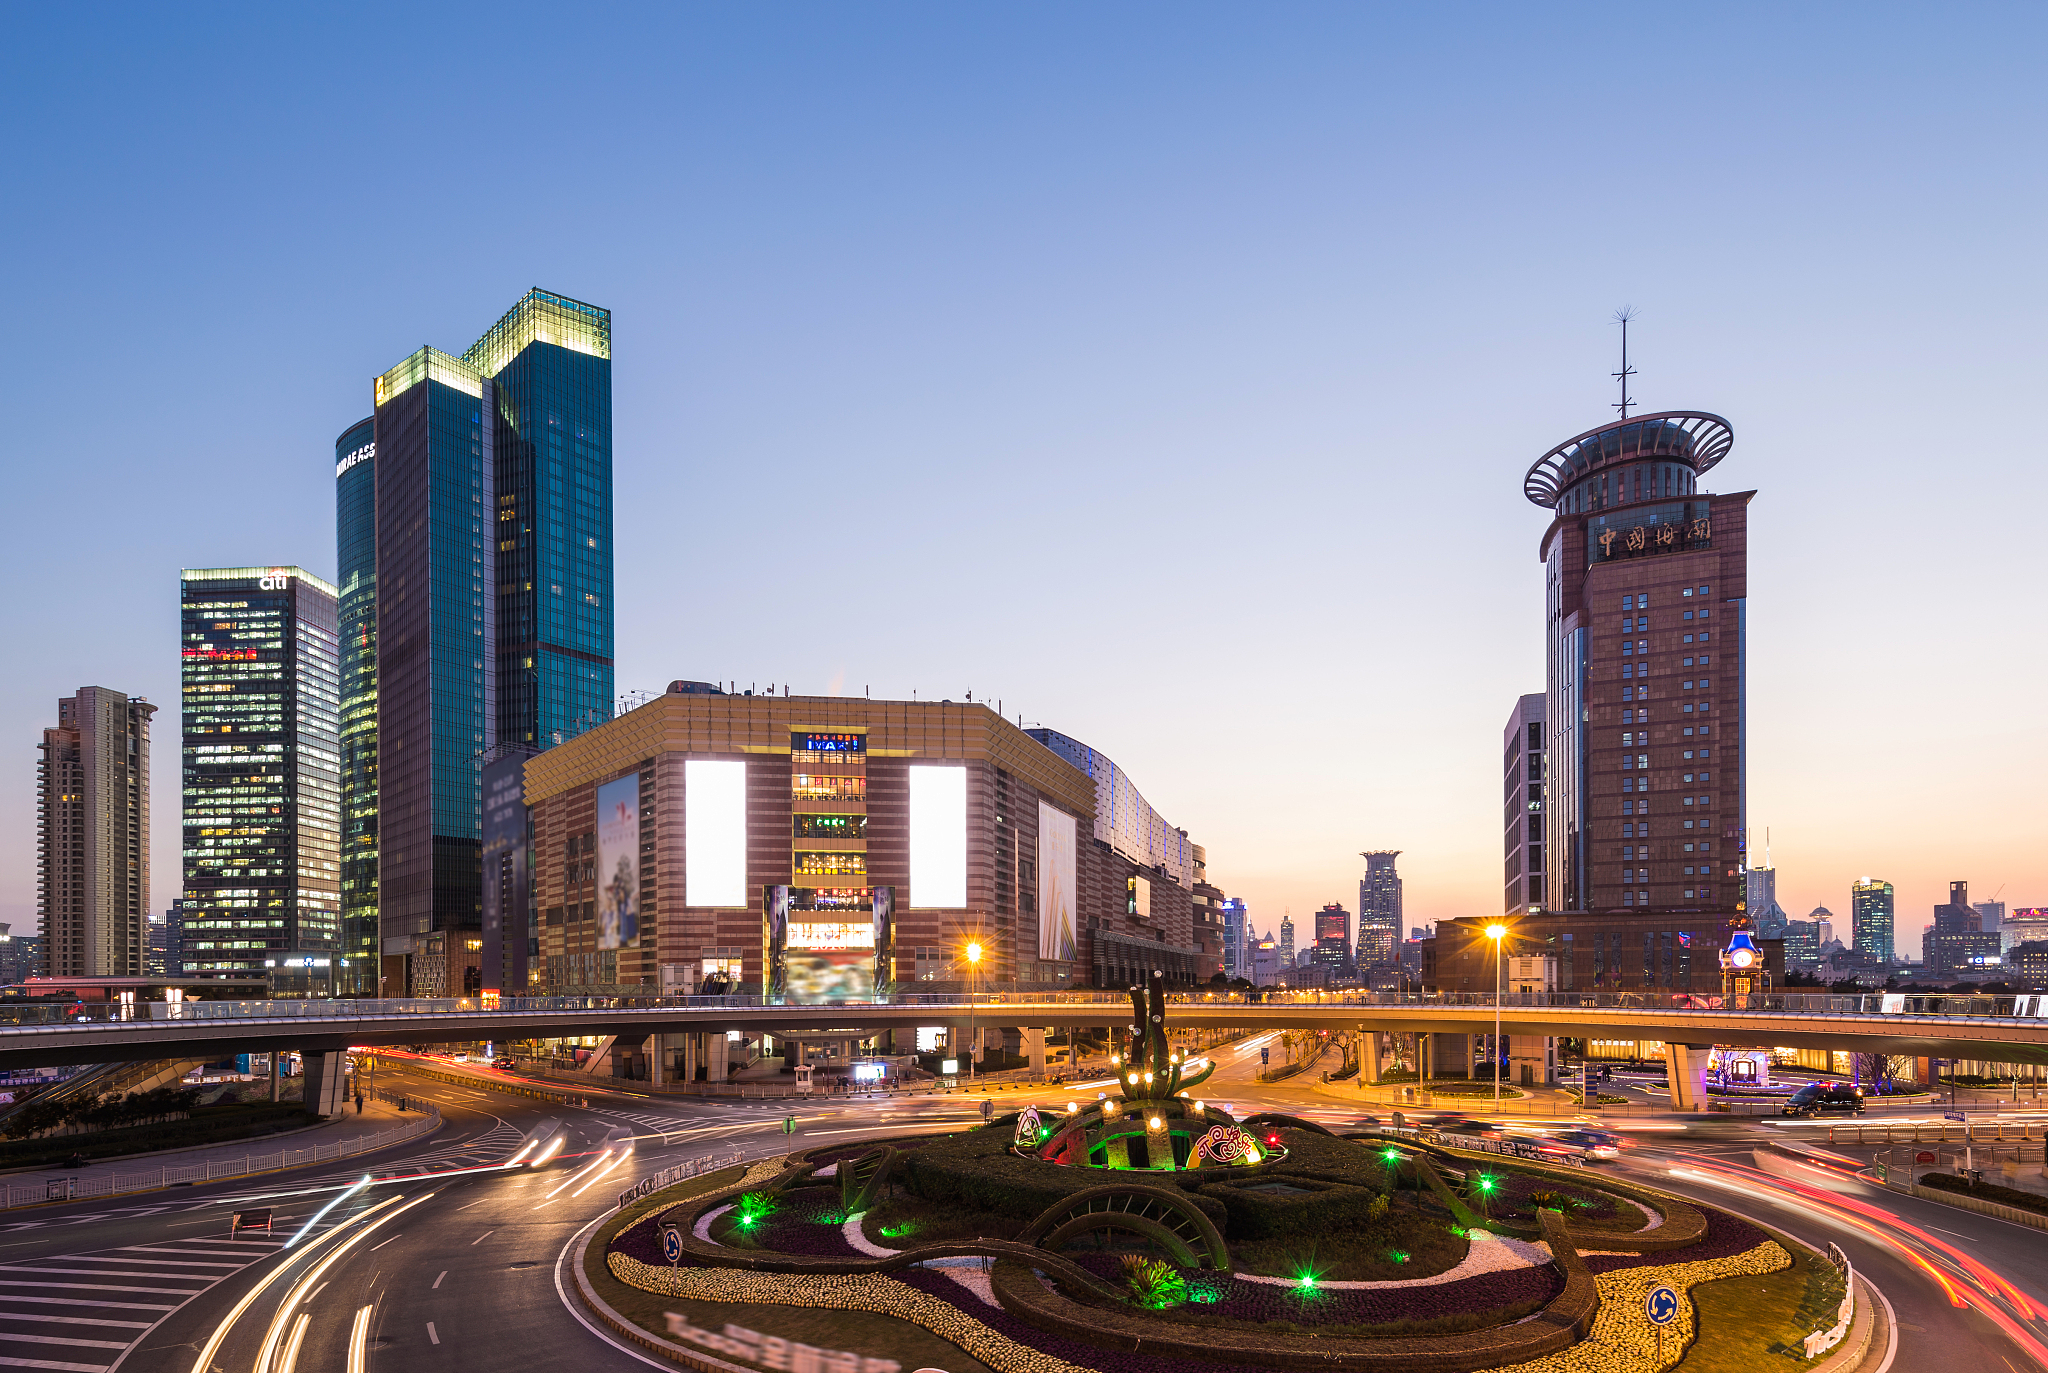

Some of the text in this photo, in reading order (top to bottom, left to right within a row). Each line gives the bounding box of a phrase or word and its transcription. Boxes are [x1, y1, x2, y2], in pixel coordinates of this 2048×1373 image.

[336, 451, 357, 478] MIRAE
[260, 576, 287, 590] citi
[807, 740, 847, 750] IMAX
